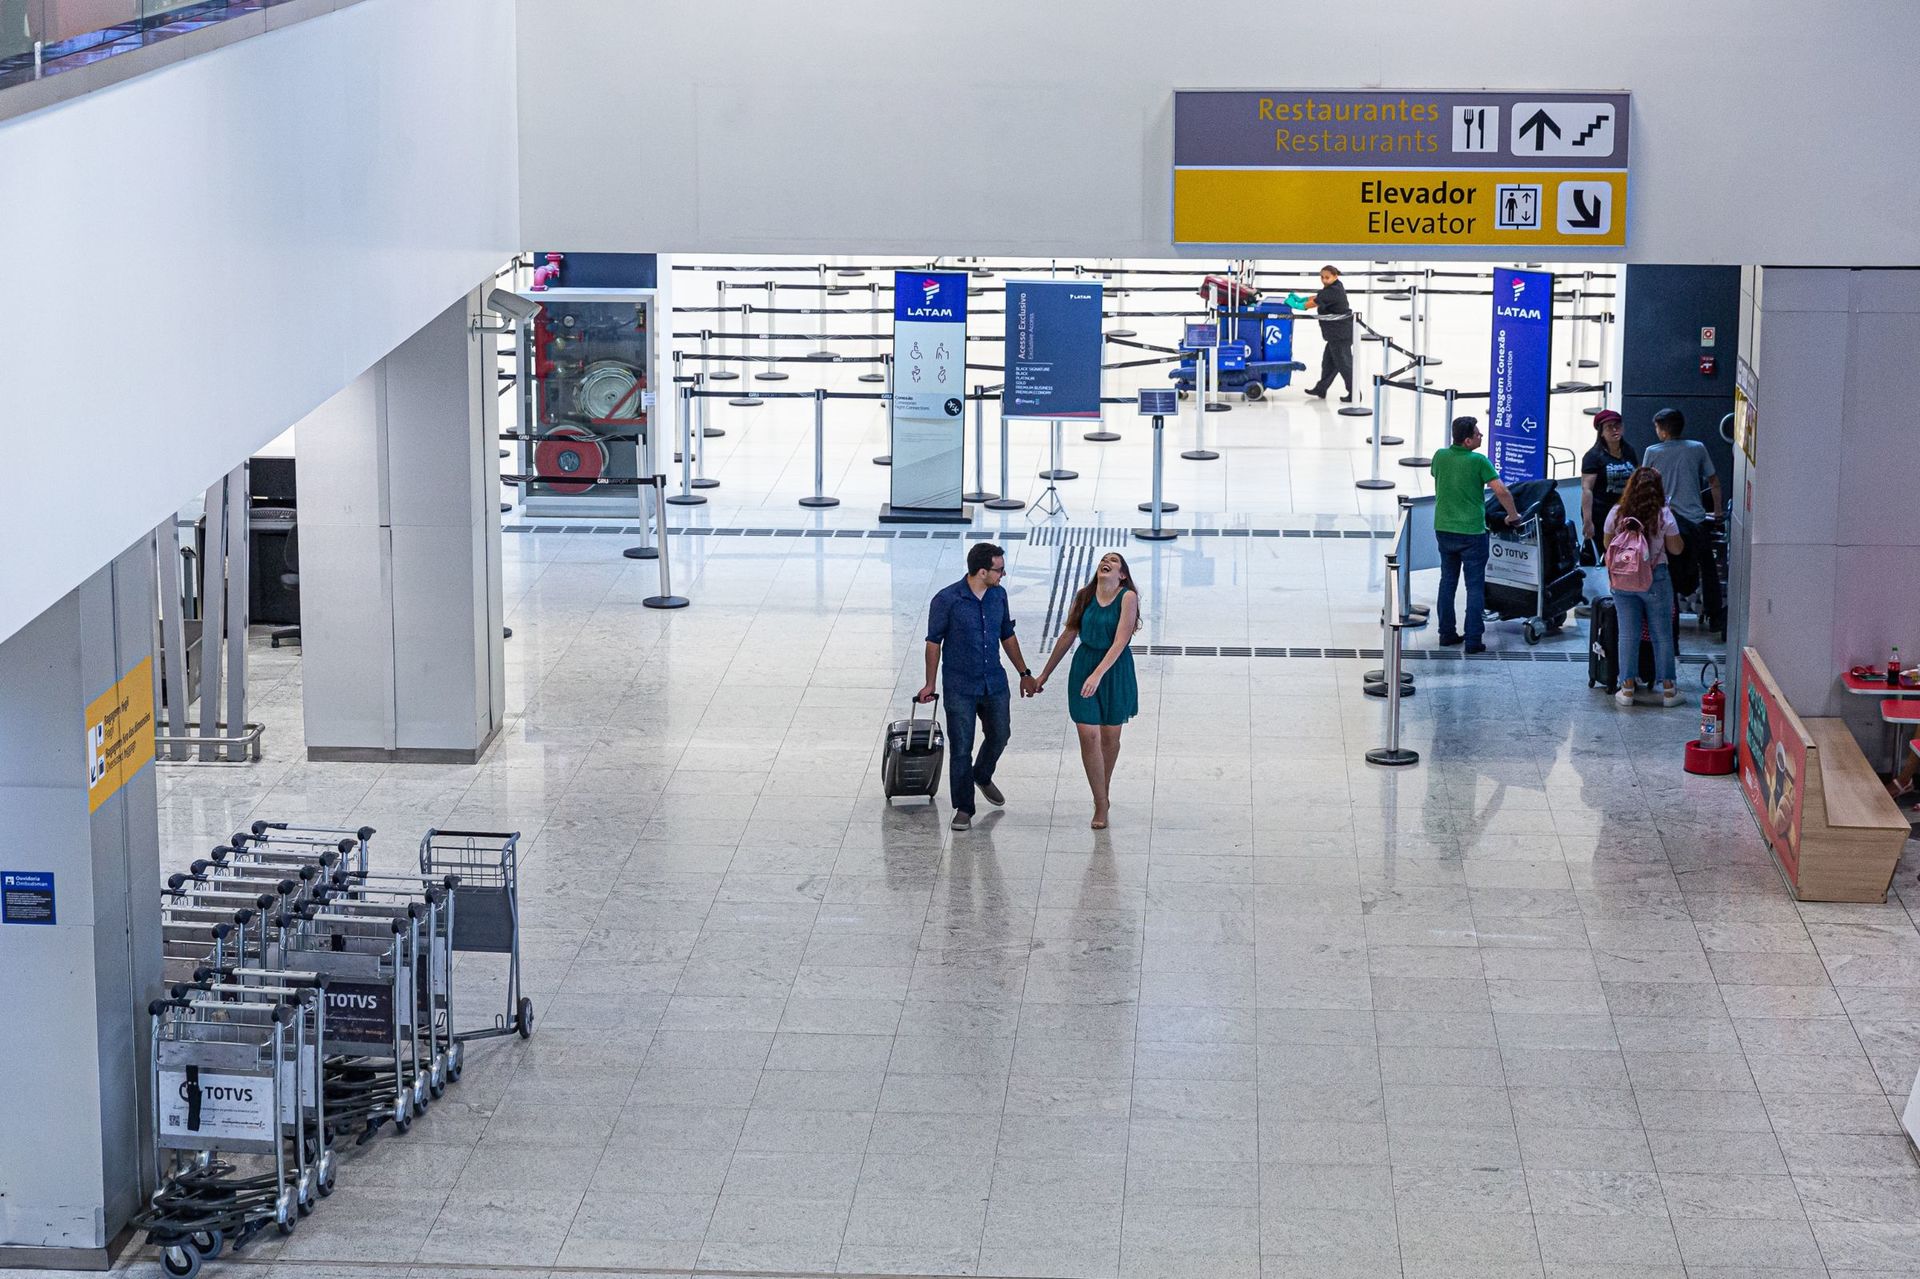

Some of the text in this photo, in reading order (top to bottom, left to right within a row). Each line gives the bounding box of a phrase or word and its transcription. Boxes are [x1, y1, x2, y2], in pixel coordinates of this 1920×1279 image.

[1259, 98, 1439, 122] Restaurantes
[1275, 128, 1439, 153] Restaurants
[1361, 180, 1477, 204] Elevador
[1368, 210, 1477, 234] Elevator
[907, 307, 952, 317] LATAM
[1497, 305, 1541, 320] LATAM
[1018, 292, 1027, 360] Acesso Exclusivo
[1495, 330, 1506, 427] Bagagem Conexão
[1505, 394, 1513, 412] Drop
[1504, 413, 1513, 428] Bag
[1504, 548, 1529, 560] TOTVS
[328, 993, 377, 1009] TOTVS
[204, 1086, 253, 1102] TOTVS
